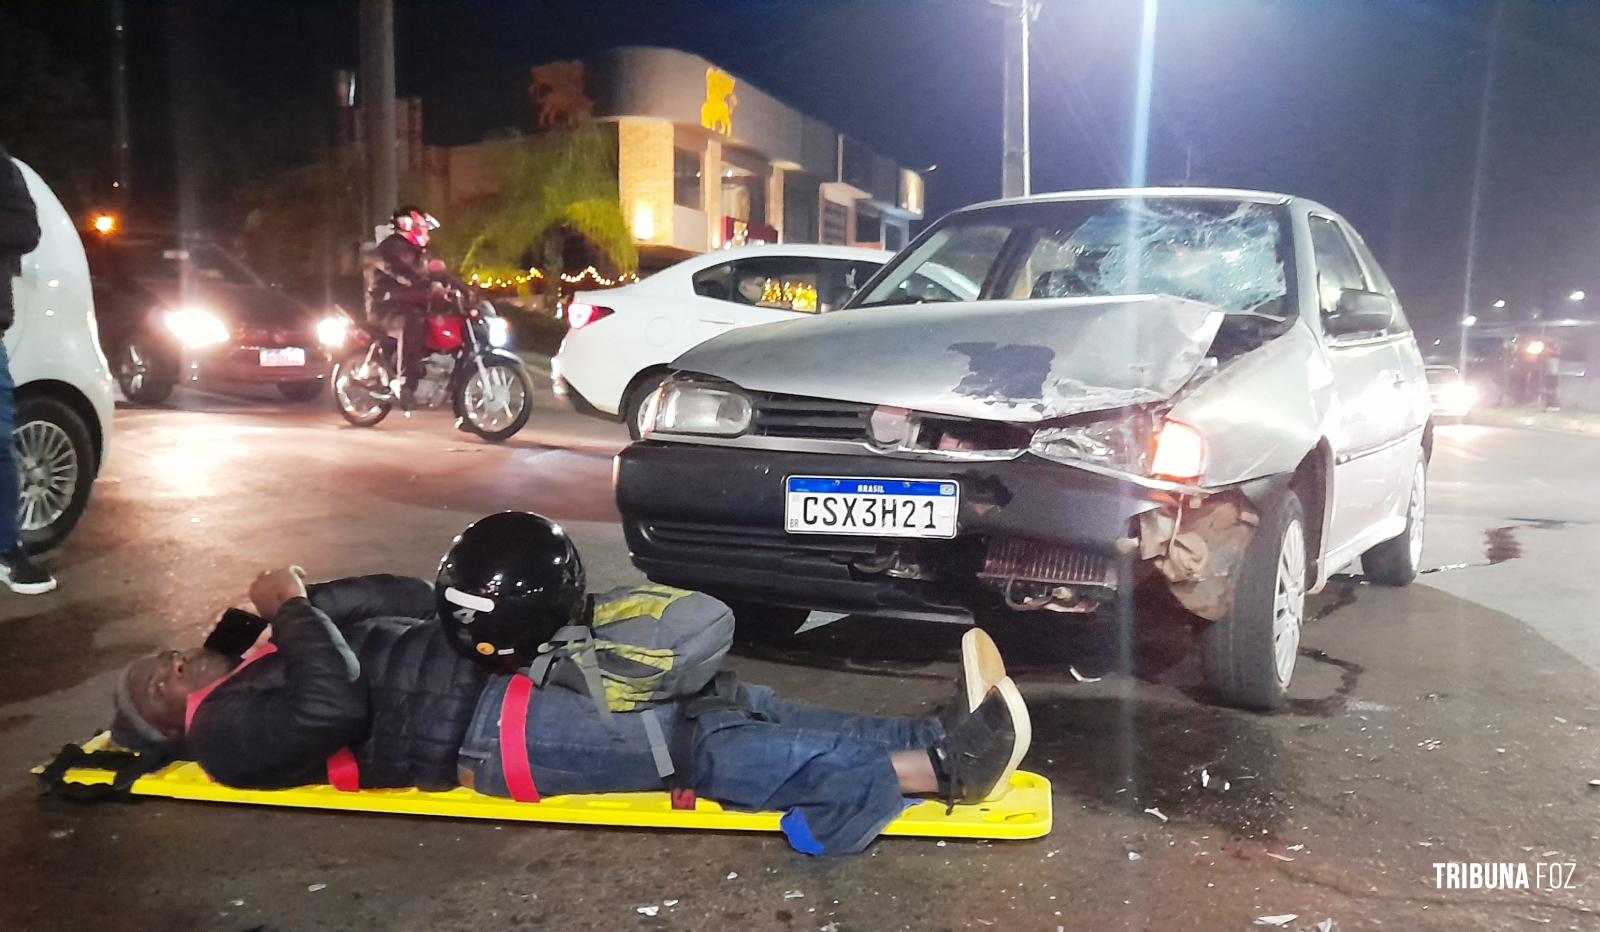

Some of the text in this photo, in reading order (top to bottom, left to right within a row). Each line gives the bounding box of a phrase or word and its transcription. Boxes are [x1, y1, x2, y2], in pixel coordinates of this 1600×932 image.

[857, 484, 885, 493] BRASIL
[803, 496, 936, 529] CSX3H21
[789, 518, 799, 528] BR
